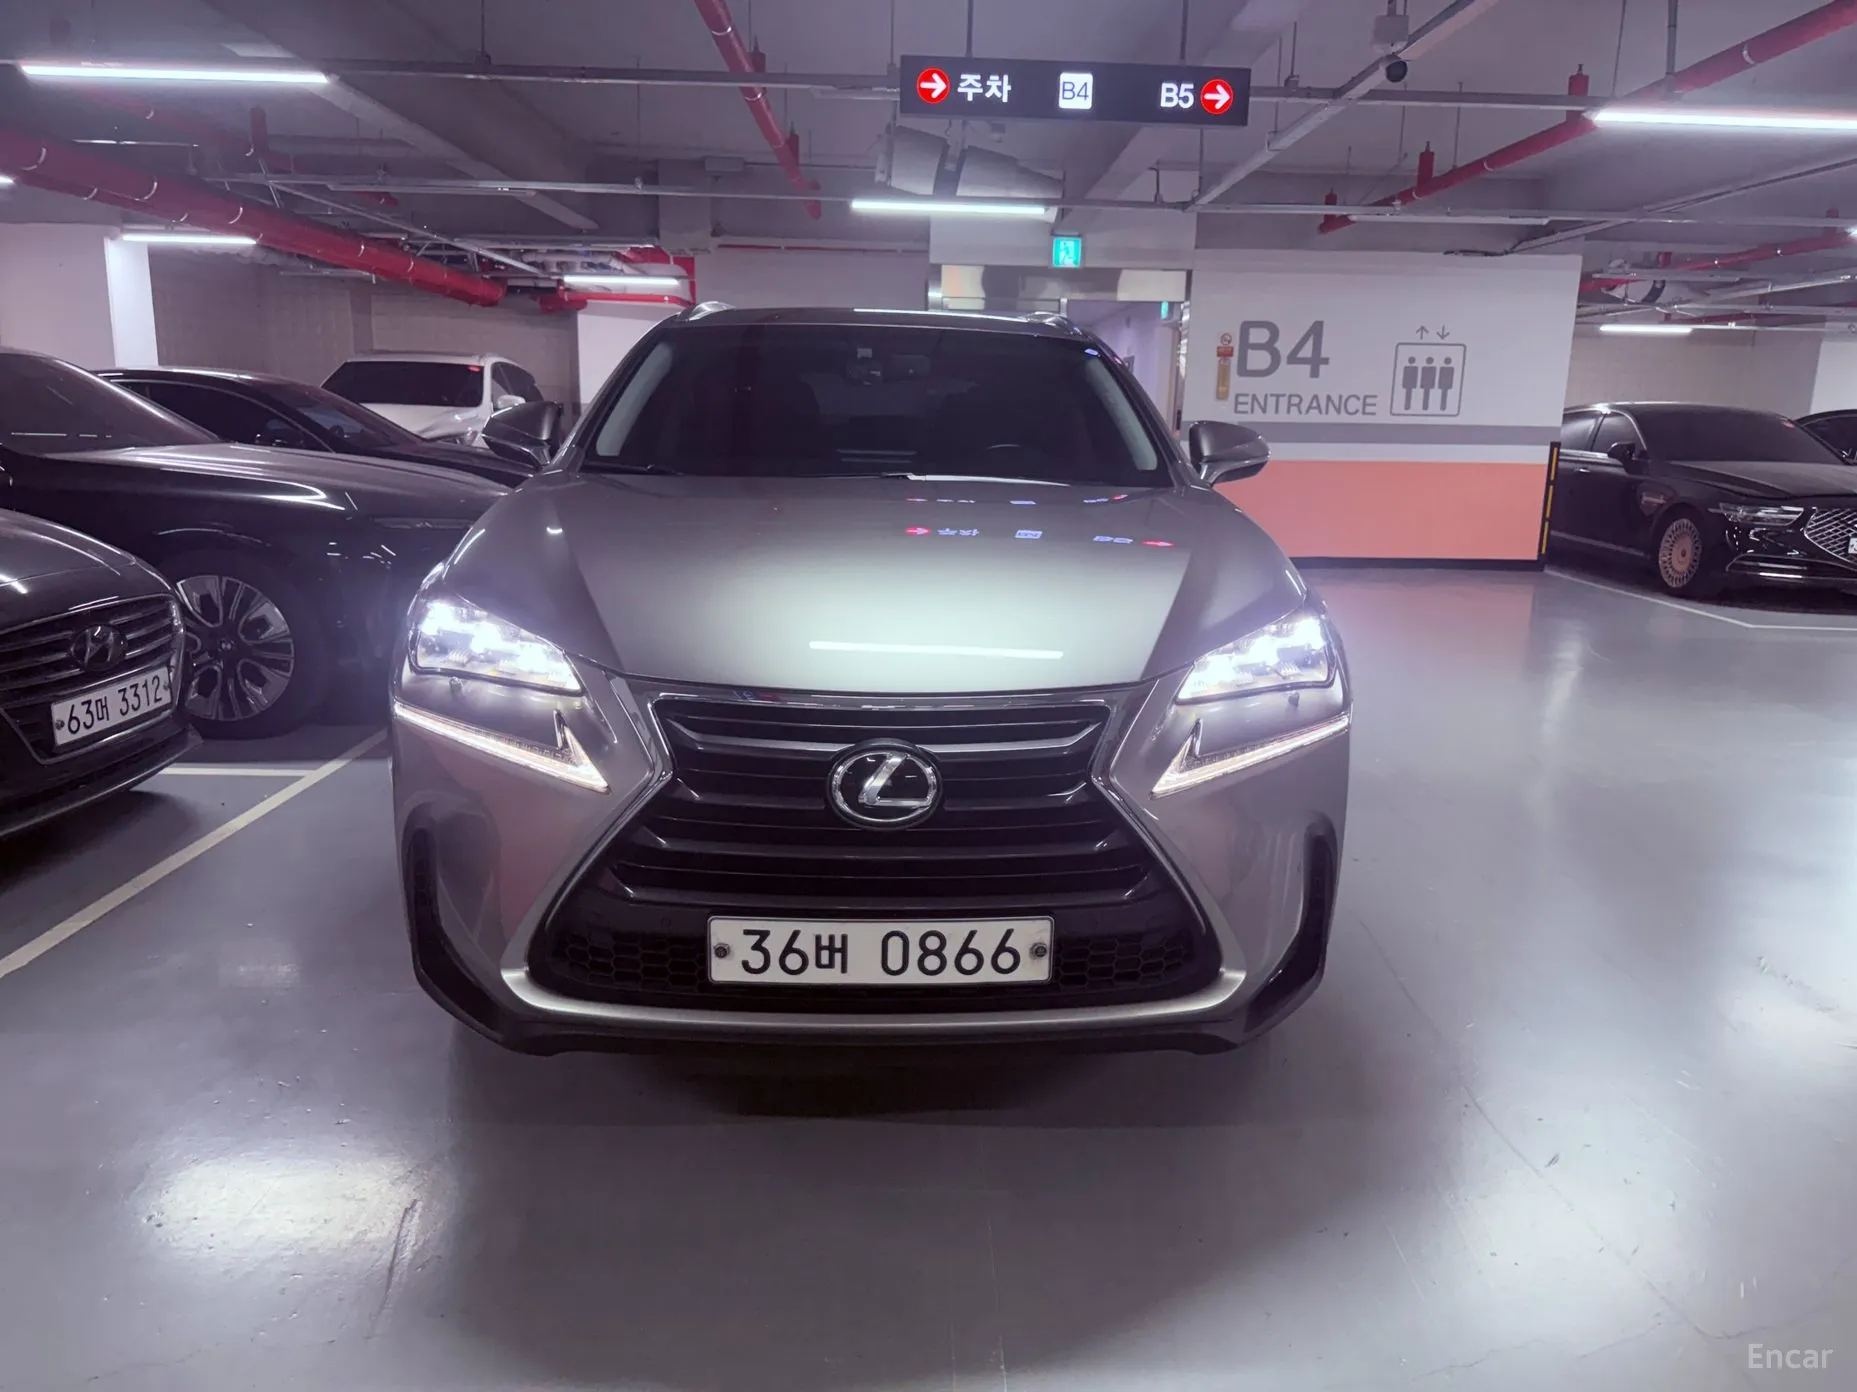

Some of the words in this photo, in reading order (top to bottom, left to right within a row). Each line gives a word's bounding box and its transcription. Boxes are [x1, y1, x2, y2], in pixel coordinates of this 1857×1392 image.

[957, 74, 1012, 103] 주차
[1061, 81, 1091, 101] B4
[1160, 82, 1195, 109] B5
[1236, 320, 1330, 379] B4
[1233, 393, 1378, 416] ENTRANCE
[67, 696, 110, 735] 63머
[117, 675, 163, 716] 3312
[741, 929, 848, 976] 36버
[881, 928, 1021, 976] 0866
